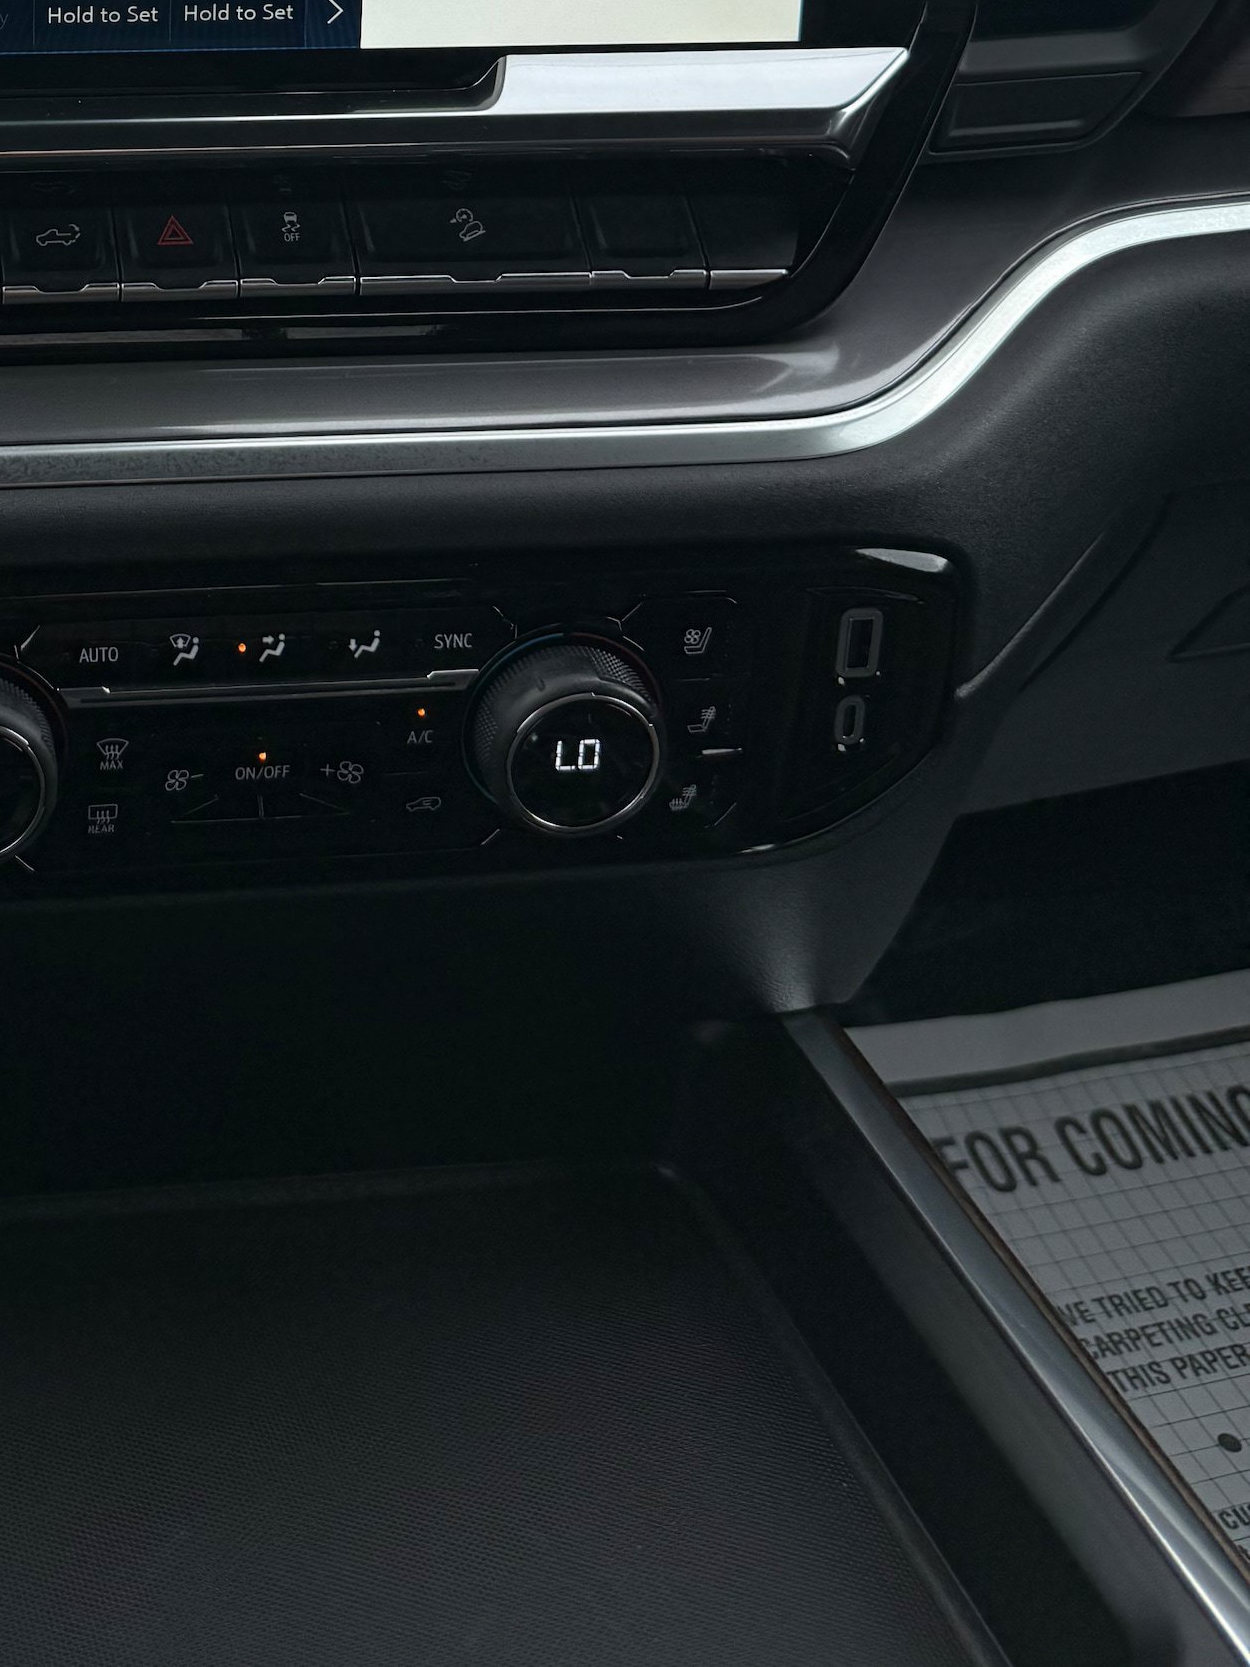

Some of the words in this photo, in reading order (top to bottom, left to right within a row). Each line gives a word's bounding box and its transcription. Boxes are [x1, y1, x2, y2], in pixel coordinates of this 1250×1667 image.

[49, 6, 94, 24] Hold
[100, 8, 121, 23] to
[127, 6, 159, 23] Set
[185, 4, 230, 22] Hold
[236, 6, 257, 21] to
[263, 4, 295, 21] Set
[284, 231, 301, 243] OFF
[434, 633, 473, 650] SYNC
[80, 646, 119, 664] AUTO
[406, 730, 433, 744] A/C
[99, 759, 124, 771] MAX
[234, 765, 291, 781] ON/OFF
[87, 823, 115, 834] REAR
[930, 1125, 1060, 1192] FOR
[1091, 1285, 1168, 1319] TRIED
[1168, 1278, 1207, 1302] TO
[1107, 1361, 1170, 1393] THIS
